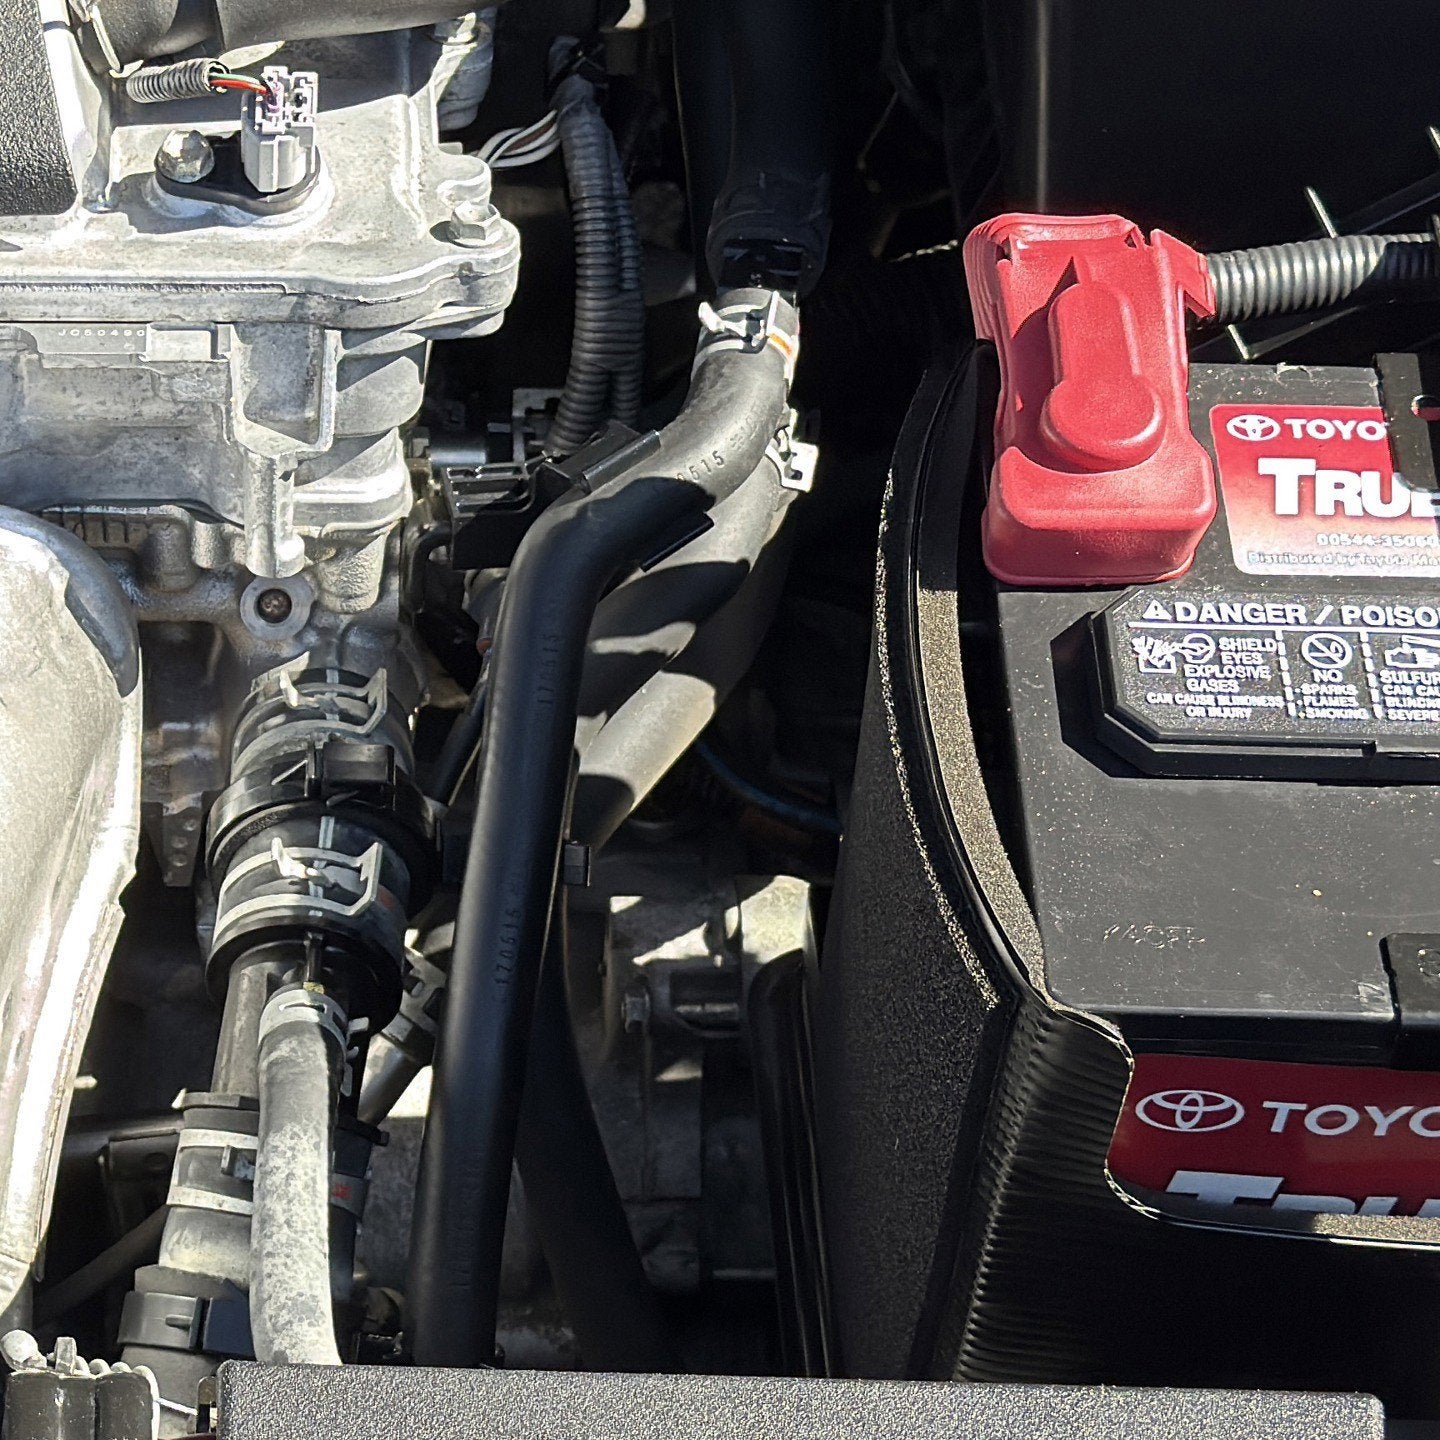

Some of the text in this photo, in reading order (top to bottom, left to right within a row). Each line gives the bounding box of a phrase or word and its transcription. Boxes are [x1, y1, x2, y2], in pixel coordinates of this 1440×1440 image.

[1284, 418, 1388, 441] TOYO
[1174, 601, 1308, 625] DANGER
[1218, 637, 1278, 653] SHIELD
[1221, 652, 1264, 666] EYES
[1184, 664, 1272, 680] EXPLOSIVE
[1312, 668, 1344, 683] NO
[1186, 679, 1241, 693] GASES
